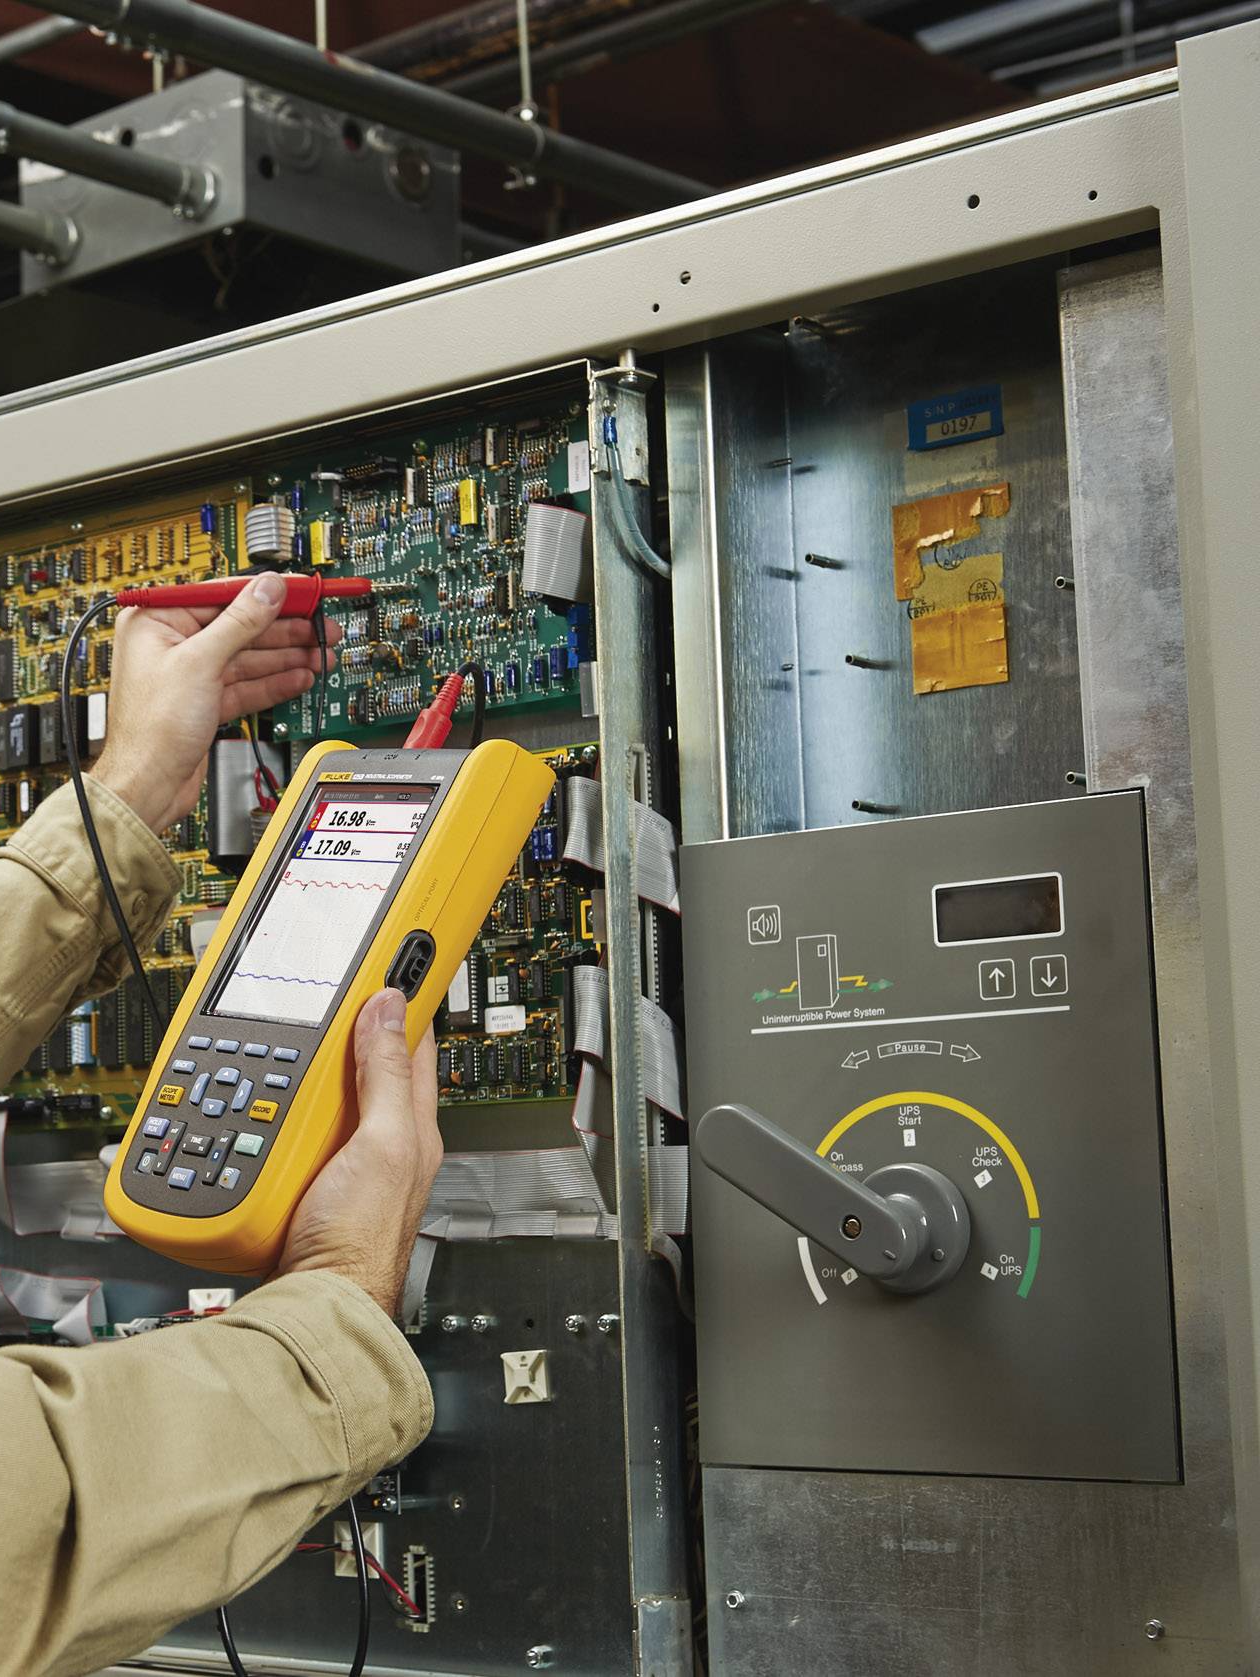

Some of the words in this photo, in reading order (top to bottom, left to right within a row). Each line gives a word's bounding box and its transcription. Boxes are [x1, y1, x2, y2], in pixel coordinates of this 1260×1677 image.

[941, 416, 978, 436] 0197
[328, 811, 367, 826] 16.98
[762, 1011, 824, 1025] Uninterruptible
[825, 1009, 851, 1019] Power
[853, 1007, 885, 1018] System
[894, 1043, 926, 1052] Pause
[266, 1075, 284, 1084] ENTER
[162, 1087, 178, 1095] SCOPE
[159, 1093, 176, 1101] METER
[252, 1105, 272, 1114] RECORD
[899, 1105, 921, 1116] UPS
[150, 1118, 163, 1126] HOLD
[898, 1115, 922, 1126] Start
[190, 1137, 203, 1145] TIME
[830, 1152, 844, 1162] On
[975, 1147, 998, 1157] UPS
[972, 1157, 1002, 1167] Check
[832, 1163, 863, 1172] ypass
[172, 1172, 187, 1181] MENU
[999, 1254, 1015, 1264] On
[822, 1268, 837, 1278] Off
[986, 1266, 993, 1275] 4
[1000, 1265, 1023, 1276] UPS
